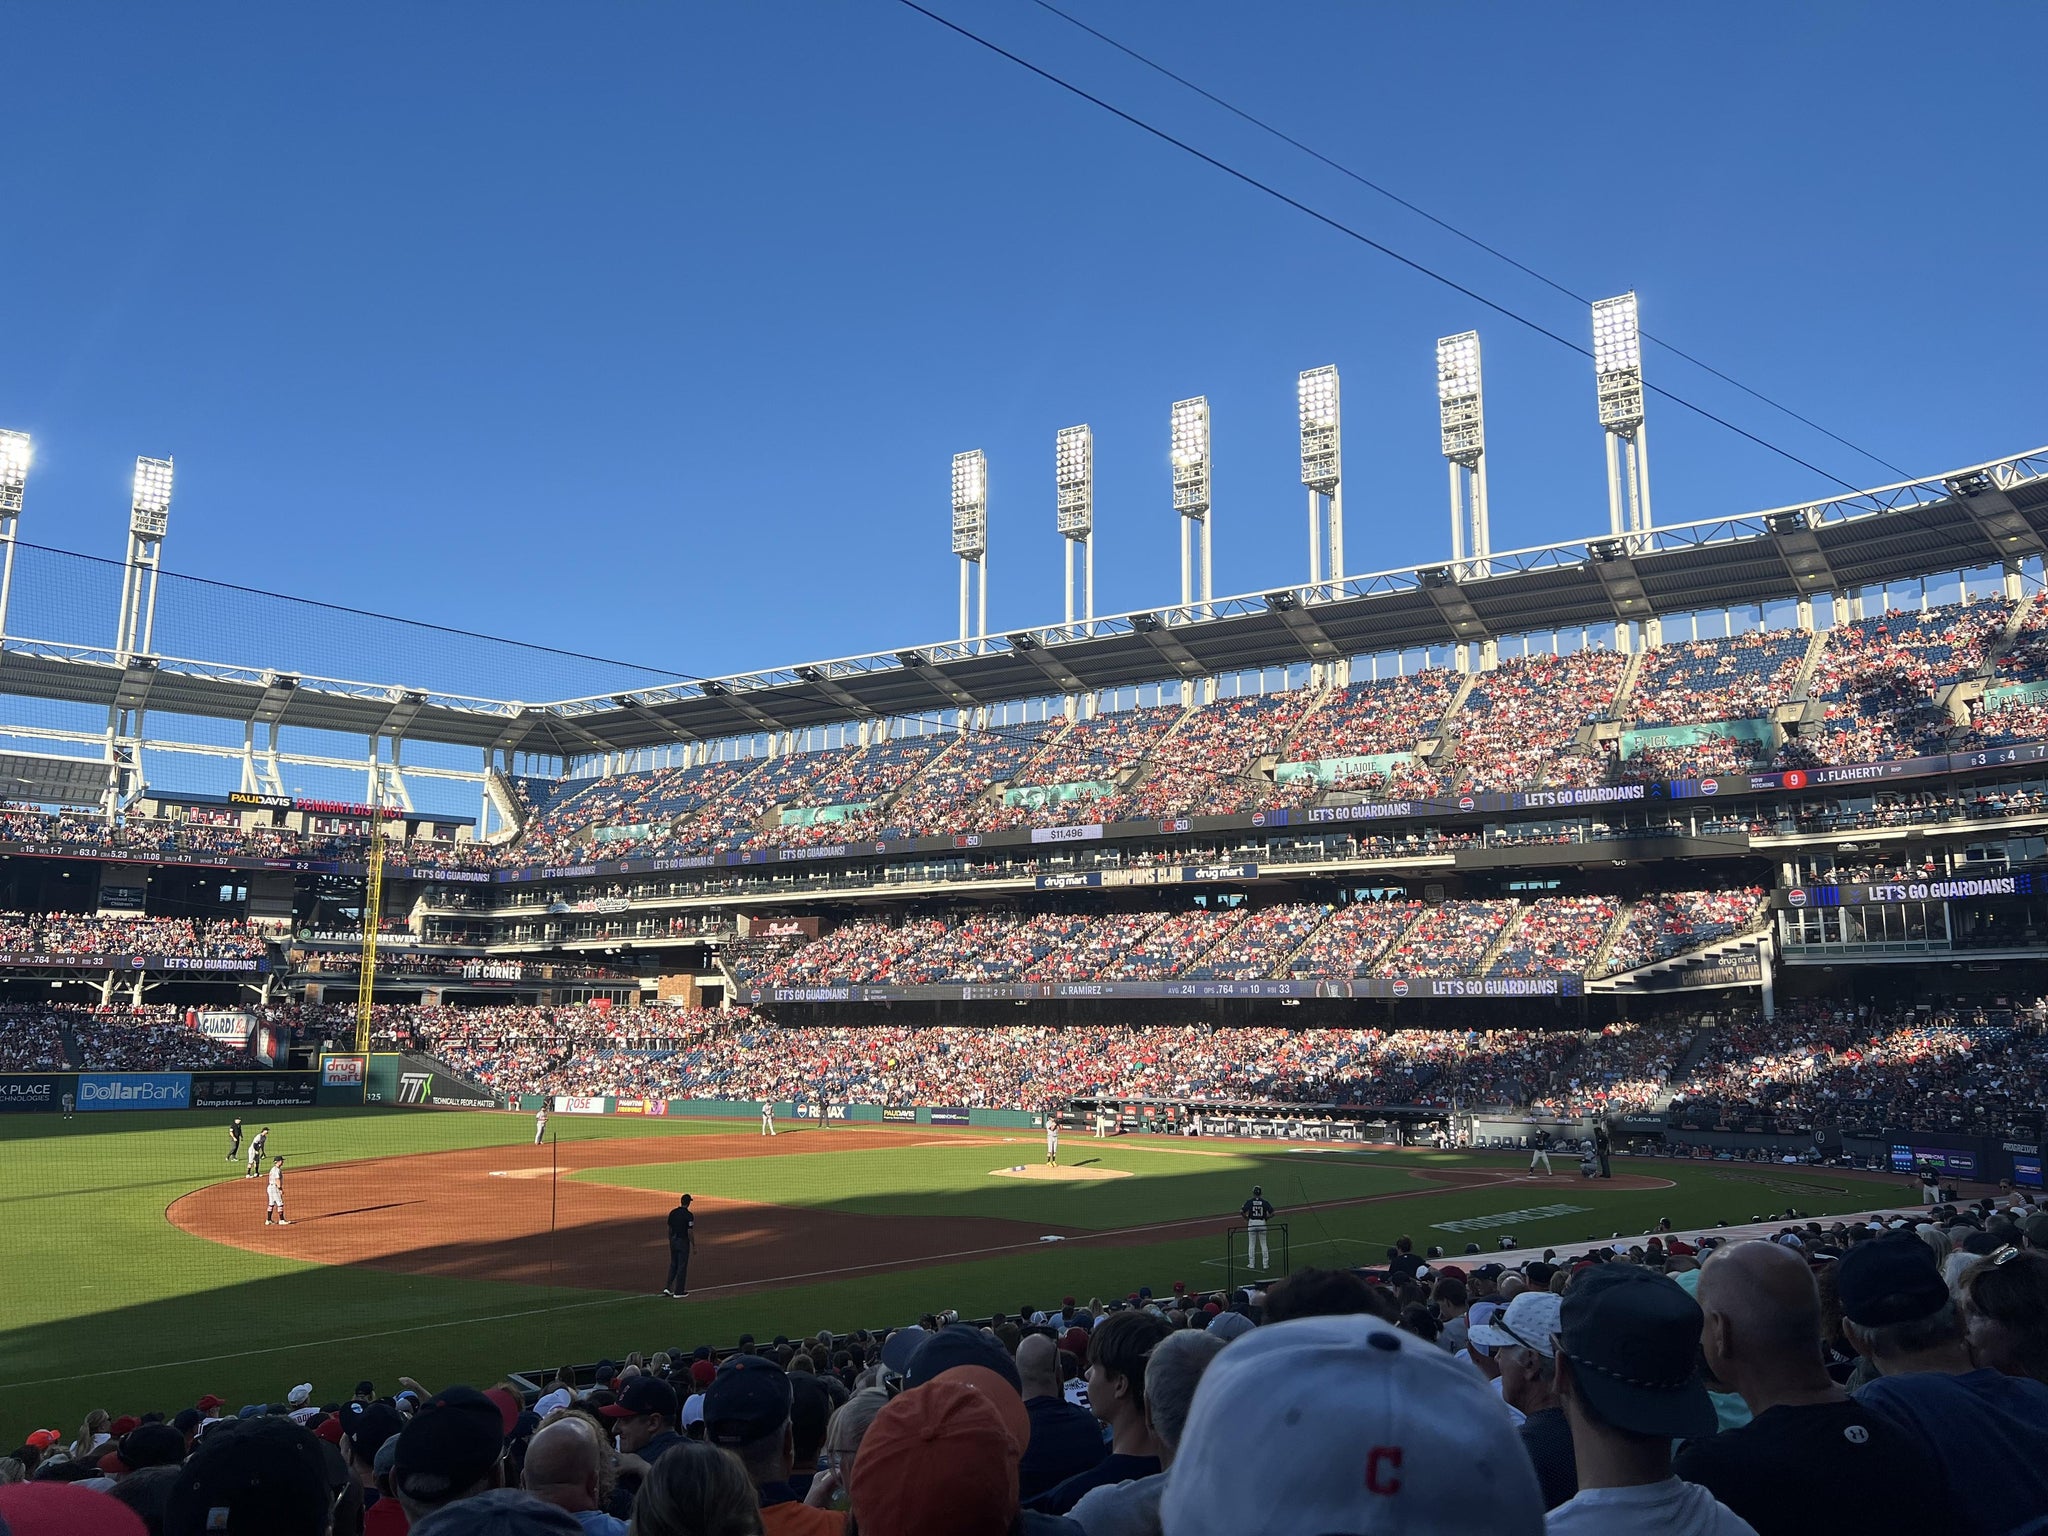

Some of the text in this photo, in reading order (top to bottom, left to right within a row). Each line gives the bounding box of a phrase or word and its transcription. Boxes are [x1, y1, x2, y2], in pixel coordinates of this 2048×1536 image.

[1634, 735, 1668, 747] FLICK
[1971, 758, 1977, 766] B
[1978, 754, 1986, 765] 3
[2008, 750, 2016, 761] 4
[2037, 746, 2045, 757] 7
[1345, 762, 1377, 774] LAJOIE
[1817, 771, 1827, 783] J.
[1828, 765, 1884, 782] FLAHERTY
[1790, 774, 1799, 786] 9
[1525, 785, 1644, 806] LET'S GO GUARDIANS!
[296, 797, 404, 819] PENNANT DISRICT
[1308, 802, 1411, 822] LET'S GO GUARDIANS!
[1050, 829, 1083, 840] $11,496
[25, 845, 35, 853] 15
[50, 846, 63, 855] 1-7
[79, 848, 97, 857] 63.0
[110, 850, 128, 859] 5.29
[143, 852, 160, 861] 11.06
[177, 854, 192, 863] 4.71
[214, 857, 229, 865] 1.57
[779, 846, 846, 860] LET'S GO GUARDIANS!
[296, 862, 309, 870] 2-2
[653, 859, 669, 870] LET'S
[669, 858, 679, 868] GO
[412, 868, 490, 882] LET'S GO GUARDIANS!
[541, 867, 557, 879] LET'S
[556, 867, 565, 877] GO
[1101, 867, 1183, 886] CHAMPIONS CLUB
[1195, 866, 1244, 880] drug mart
[1044, 875, 1088, 888] drug mart
[1868, 877, 2016, 901] LET'S GO GUARDIANS!
[578, 900, 597, 912] kids
[314, 931, 333, 940] FAT
[335, 932, 372, 941] HEADS
[31, 956, 50, 964] .764
[92, 957, 104, 965] 33
[163, 958, 257, 970] LET'S GO GUARDIANS!
[1717, 957, 1737, 966] drug
[1737, 955, 1757, 964] mart
[462, 965, 522, 980] THE CORNER
[1681, 964, 1761, 986] CHAMPIONS CLUB
[1001, 988, 1006, 996] 2
[1043, 986, 1050, 996] 11
[1060, 986, 1068, 995] J.
[1069, 983, 1101, 995] RAMÍREZ
[1179, 984, 1196, 994] .241
[1215, 984, 1233, 994] .764
[1250, 984, 1260, 994] 10
[1279, 984, 1290, 994] 33
[1432, 979, 1558, 995] LET'S GO GUARDIANS!
[774, 988, 849, 1000] LET'S GO GUARDIANS!
[202, 1018, 235, 1034] GUARDS
[327, 1060, 356, 1076] drug
[328, 1074, 362, 1083] mart
[10, 1084, 51, 1095] PLACE
[196, 1099, 253, 1108] Dumpsters.com
[257, 1098, 311, 1106] Dumpsters.com
[460, 1098, 477, 1107] PEOPLE
[566, 1098, 591, 1112] ROSE
[1366, 1446, 1402, 1495] C
